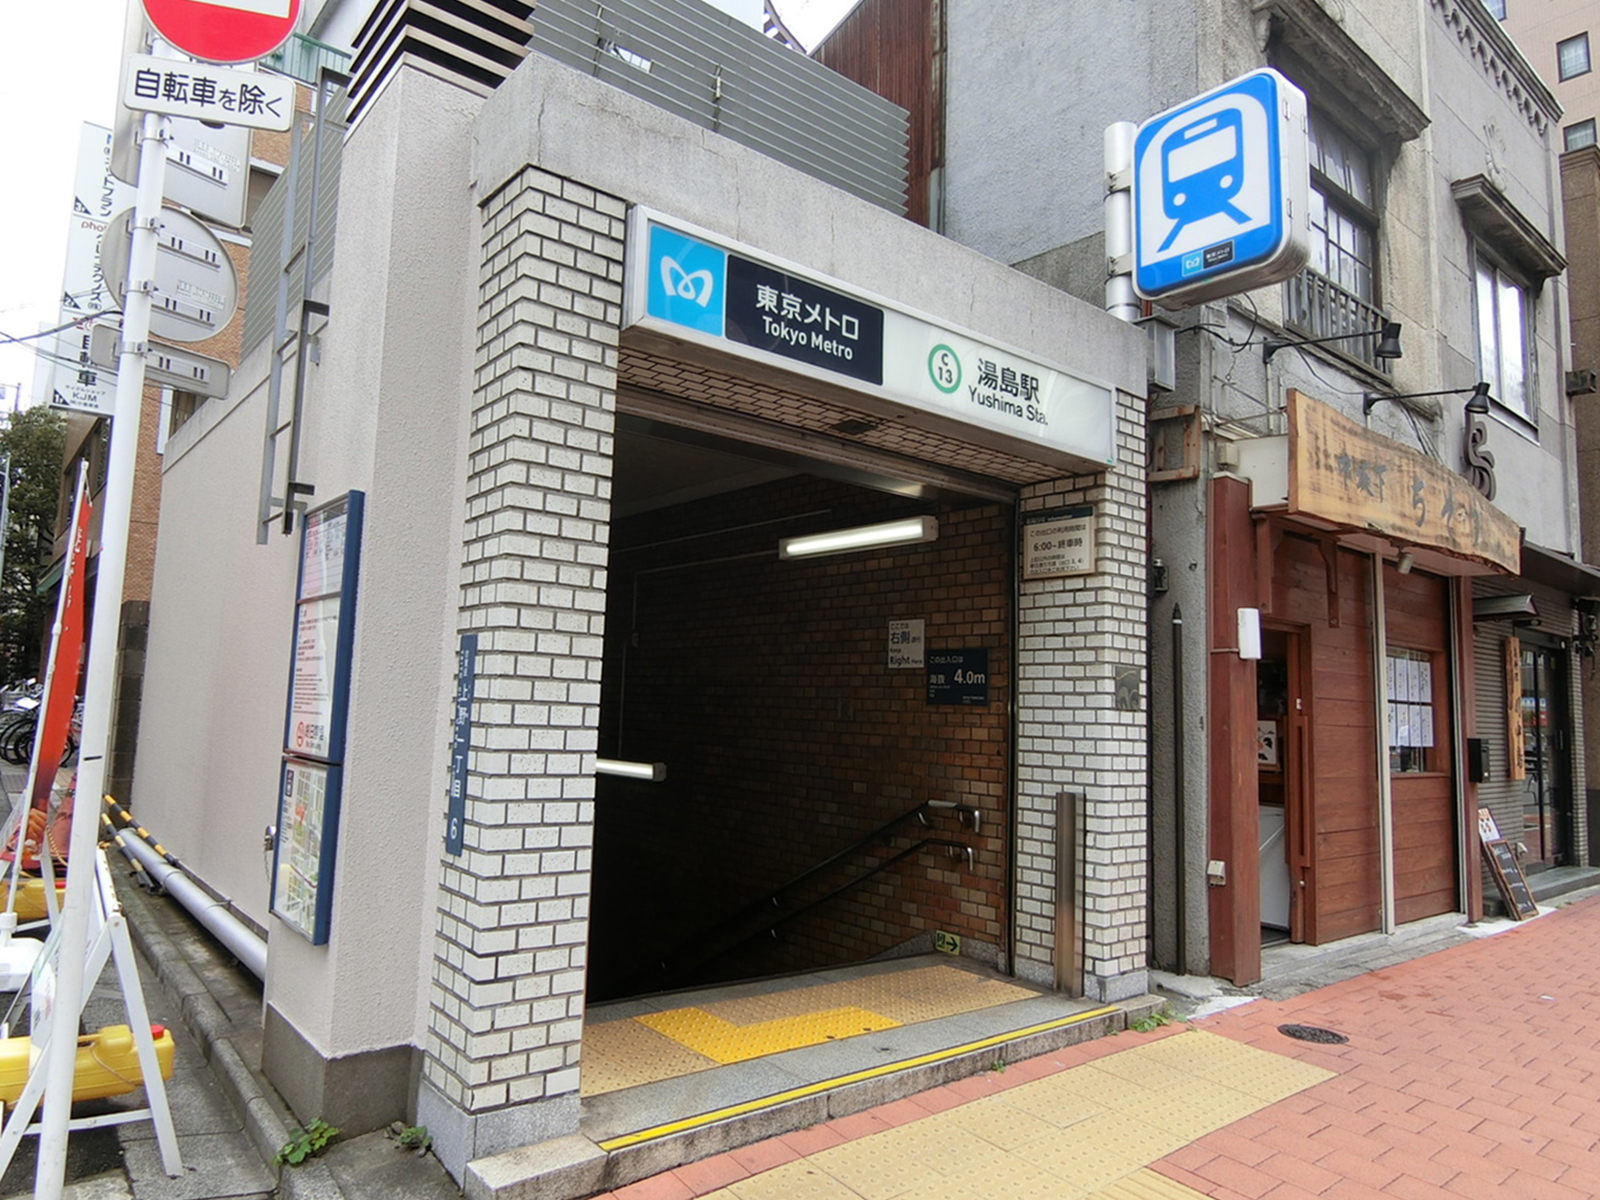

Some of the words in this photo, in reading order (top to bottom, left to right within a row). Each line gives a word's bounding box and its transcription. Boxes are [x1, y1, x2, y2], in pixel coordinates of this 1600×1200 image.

[135, 68, 283, 118] 自転車を除く
[756, 284, 859, 340] 東京メトロ
[762, 315, 807, 346] Tokyo
[811, 331, 853, 360] Metro
[941, 353, 949, 367] C
[938, 366, 953, 384] 13
[977, 358, 1041, 404] 湯島駅
[72, 391, 98, 402] KJM
[968, 385, 1023, 418] Yushima
[1026, 404, 1049, 425] Sta.
[890, 655, 911, 667] Right
[929, 655, 964, 665] この出入口は
[954, 668, 986, 685] 4.0m
[450, 817, 458, 840] 6
